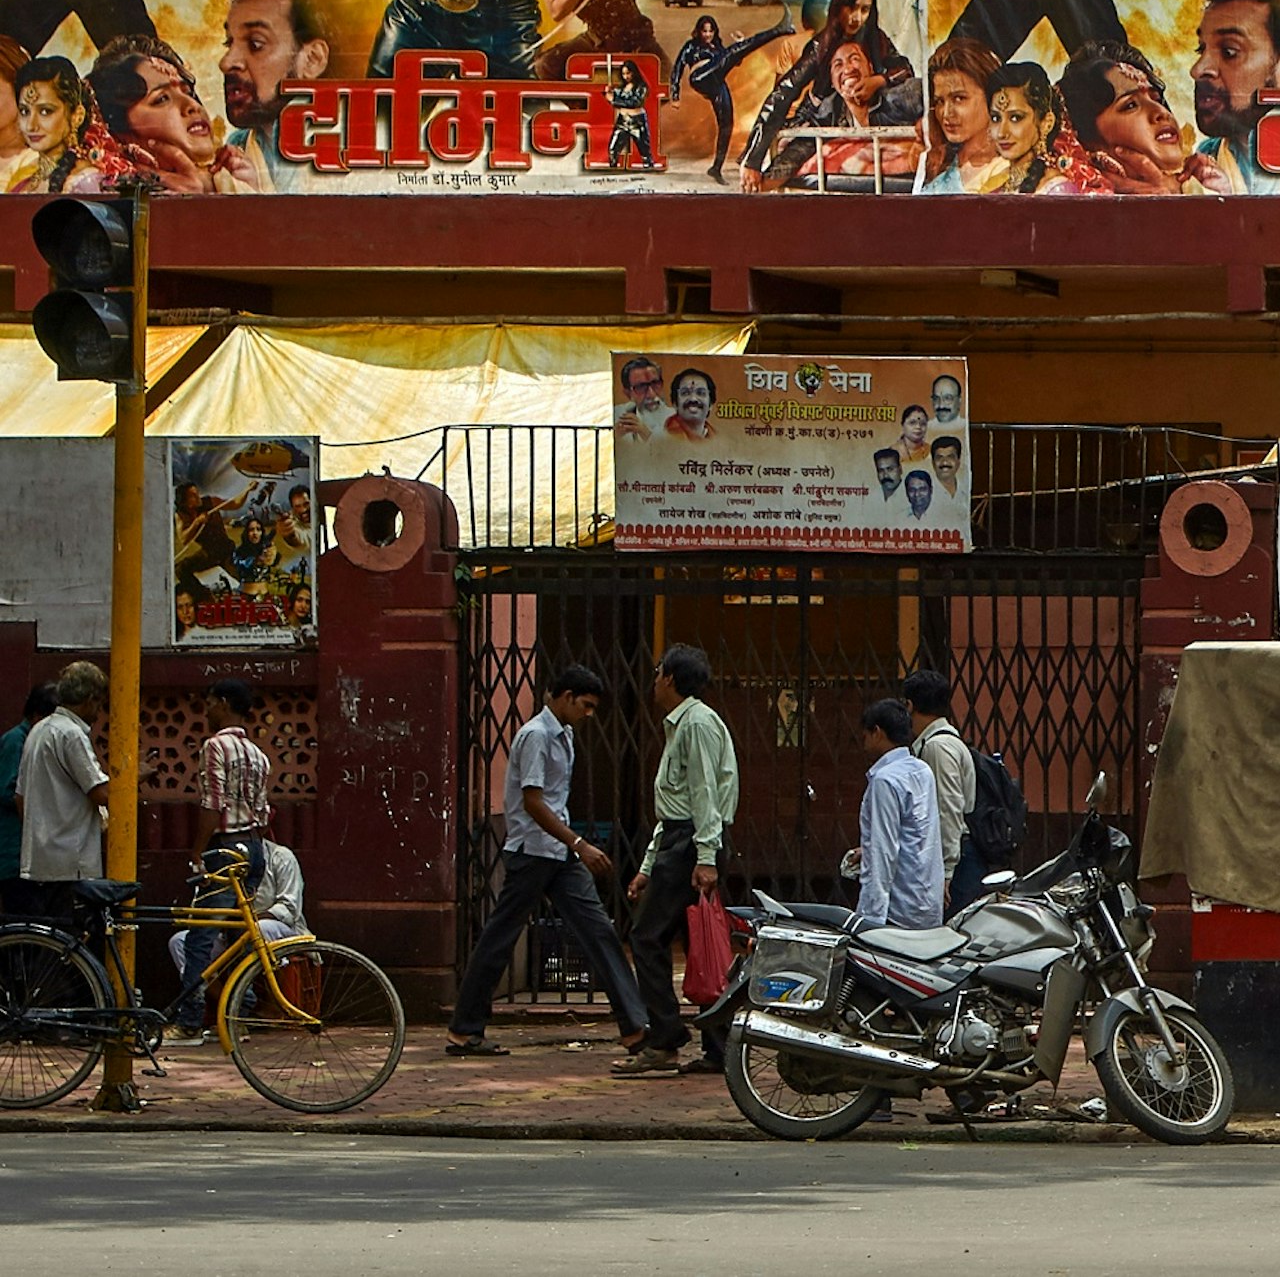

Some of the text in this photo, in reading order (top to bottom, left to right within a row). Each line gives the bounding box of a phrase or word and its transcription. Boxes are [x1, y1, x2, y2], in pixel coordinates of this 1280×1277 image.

[279, 49, 671, 172] दामिनी
[397, 171, 428, 185] निर्माता
[487, 173, 518, 190] कुमार
[744, 362, 873, 393] शिव सेना
[717, 397, 896, 422] अखिल मुंबई चित्रपट कामगार संघ
[757, 465, 791, 478] (अध्यक्ष
[801, 465, 835, 479] उपनेते)
